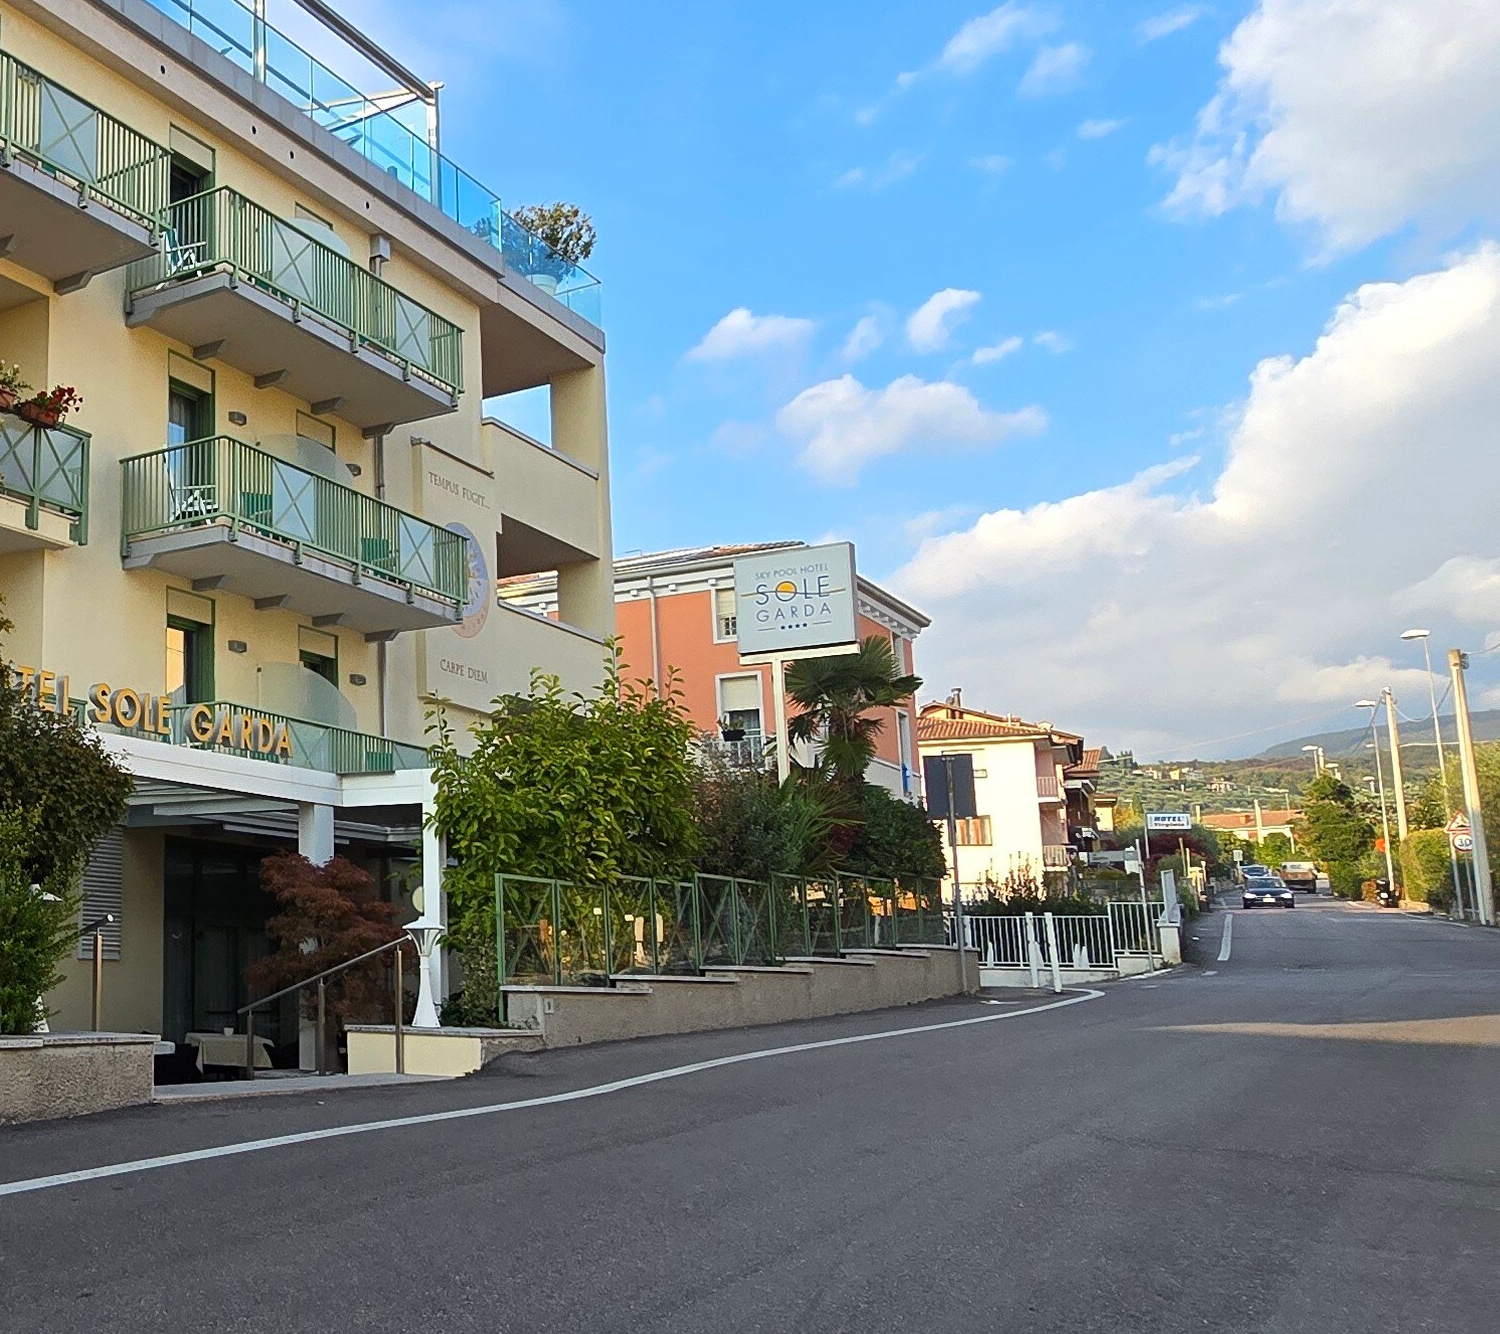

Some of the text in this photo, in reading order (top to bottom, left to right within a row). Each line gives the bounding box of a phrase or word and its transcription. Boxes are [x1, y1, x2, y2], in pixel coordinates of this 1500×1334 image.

[428, 471, 460, 496] TEMPUS
[755, 563, 828, 581] SKY POOL HOTEL
[755, 575, 830, 606] SOLE
[756, 602, 832, 623] GARDA
[440, 658, 489, 684] CARPE DIEM
[16, 664, 293, 759] TEL SOLE GARDA
[1457, 837, 1473, 847] 30
